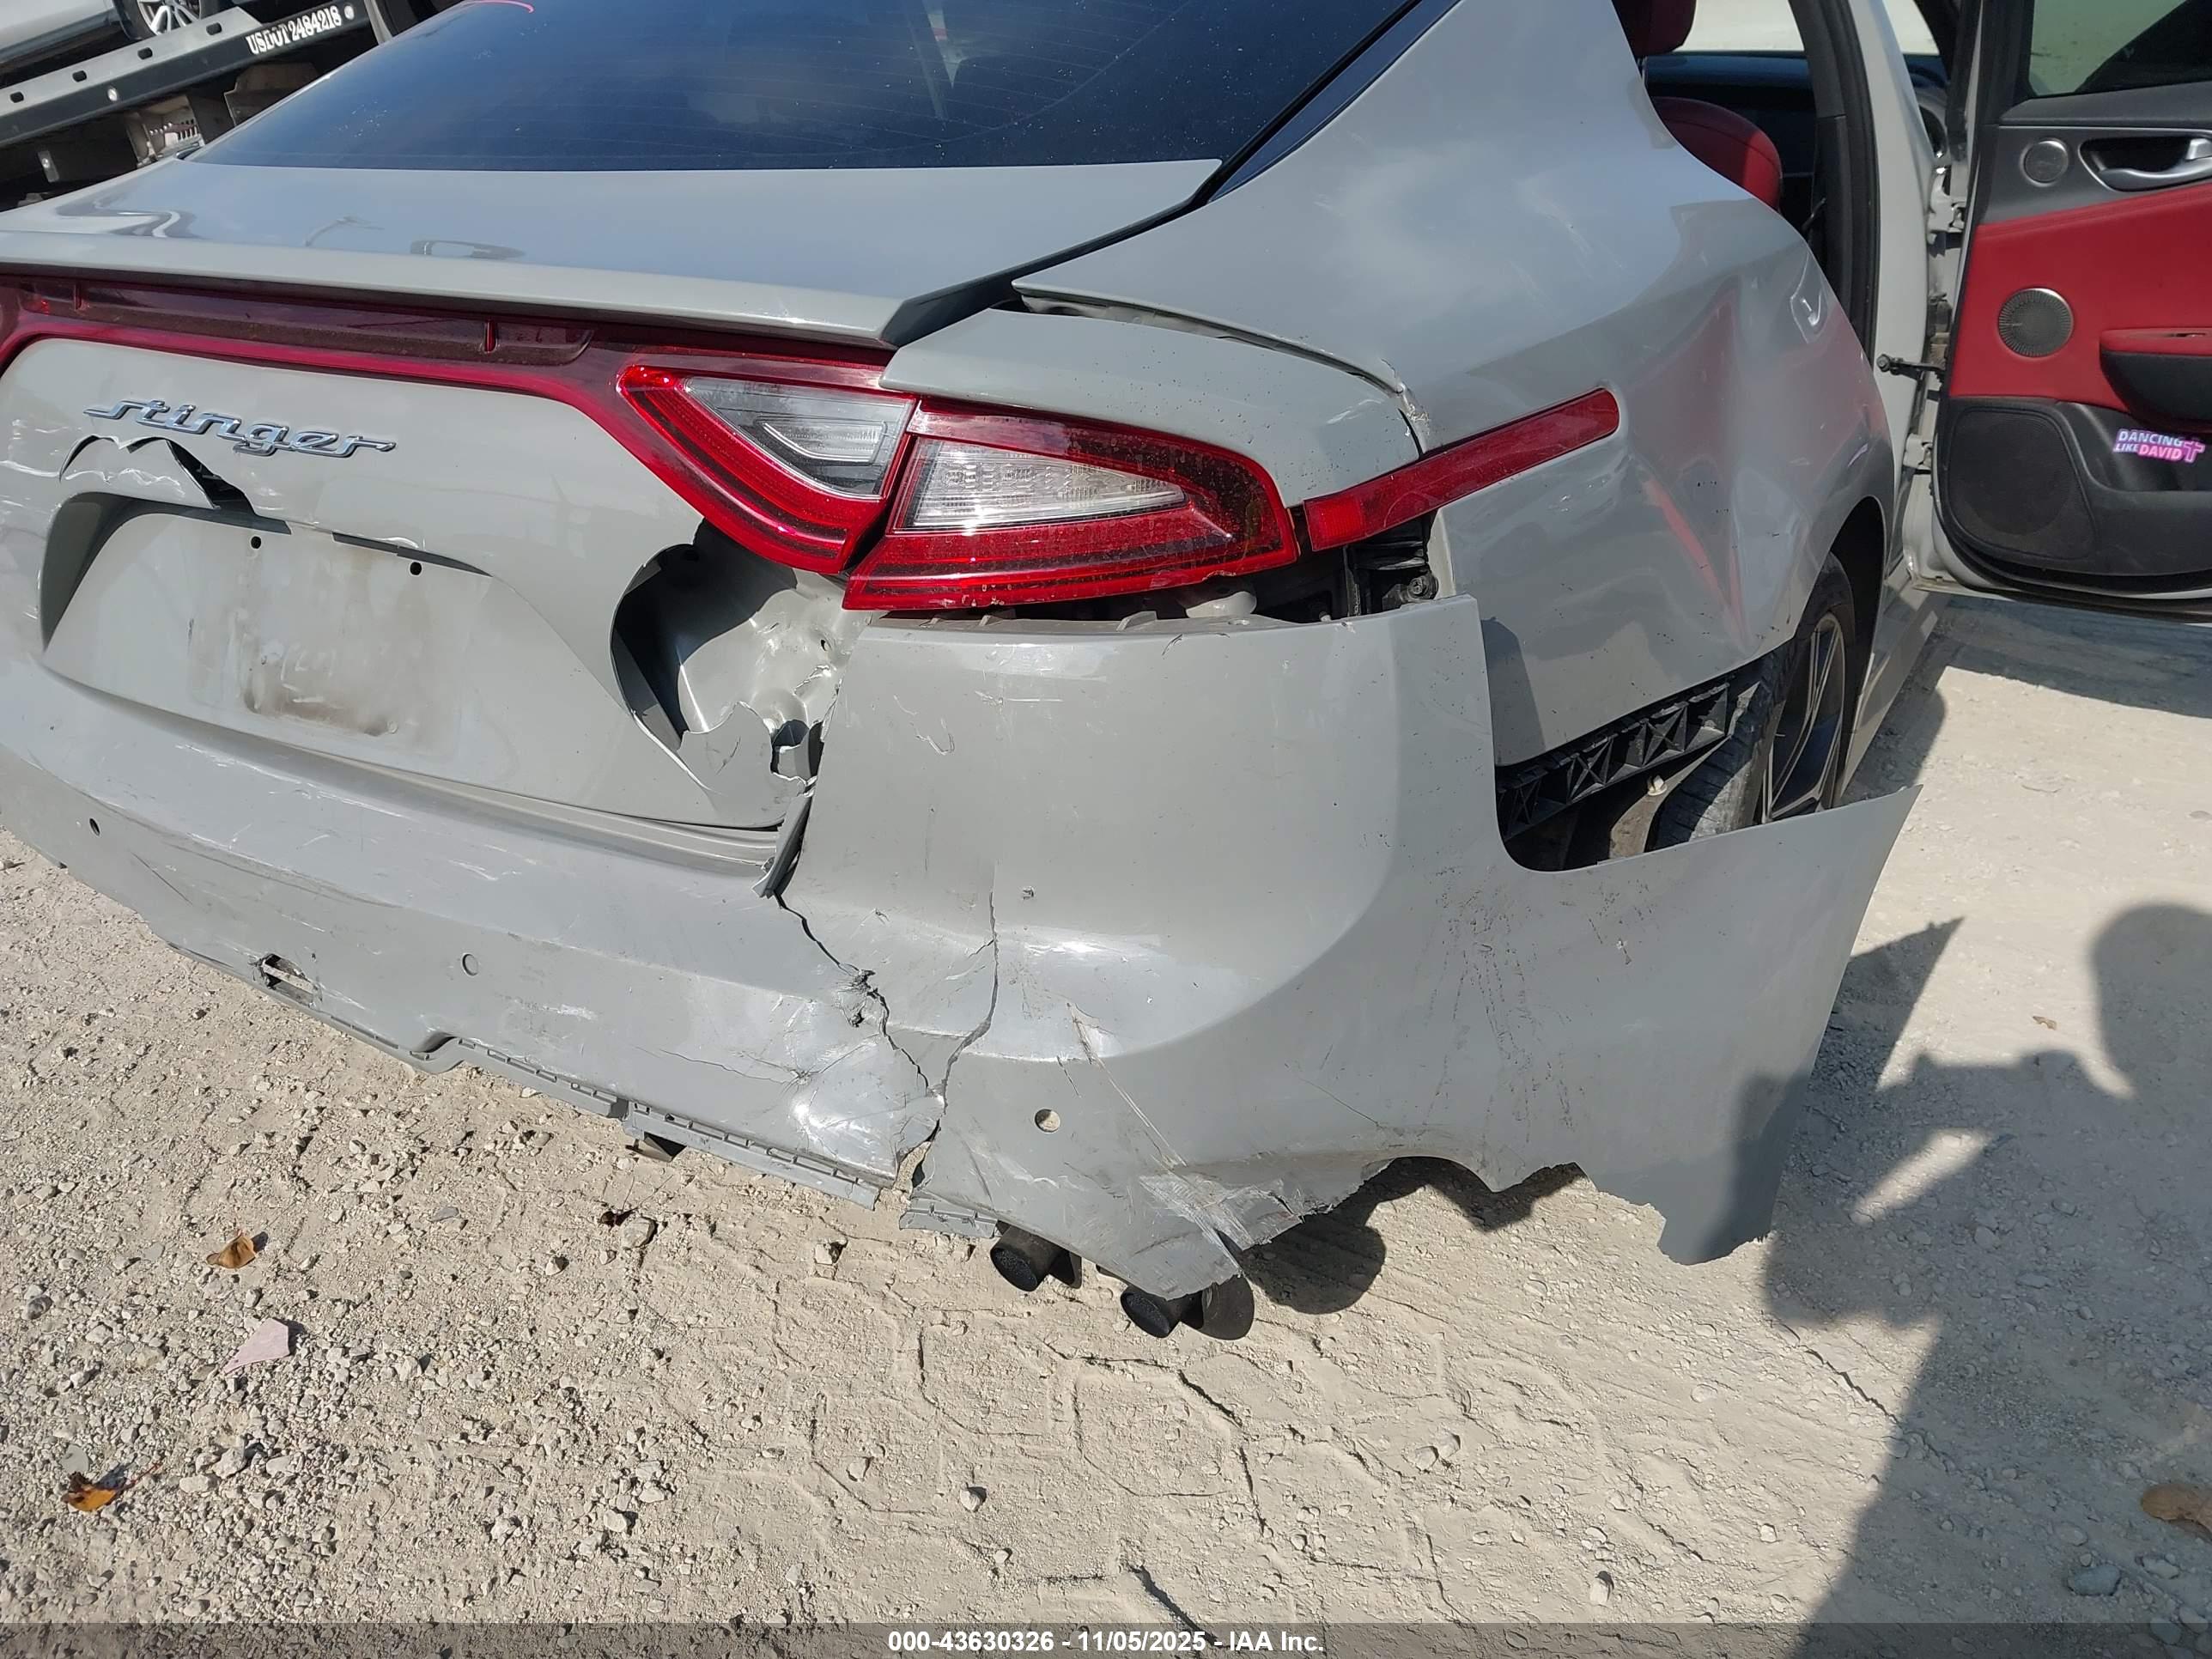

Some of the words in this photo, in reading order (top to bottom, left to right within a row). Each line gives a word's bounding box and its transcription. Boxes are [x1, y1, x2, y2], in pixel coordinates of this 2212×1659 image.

[245, 24, 290, 55] USDOT
[288, 5, 342, 41] 2484218
[2118, 430, 2184, 447] DANCING
[2113, 443, 2139, 453] LIKE
[2138, 445, 2183, 461] DAVID
